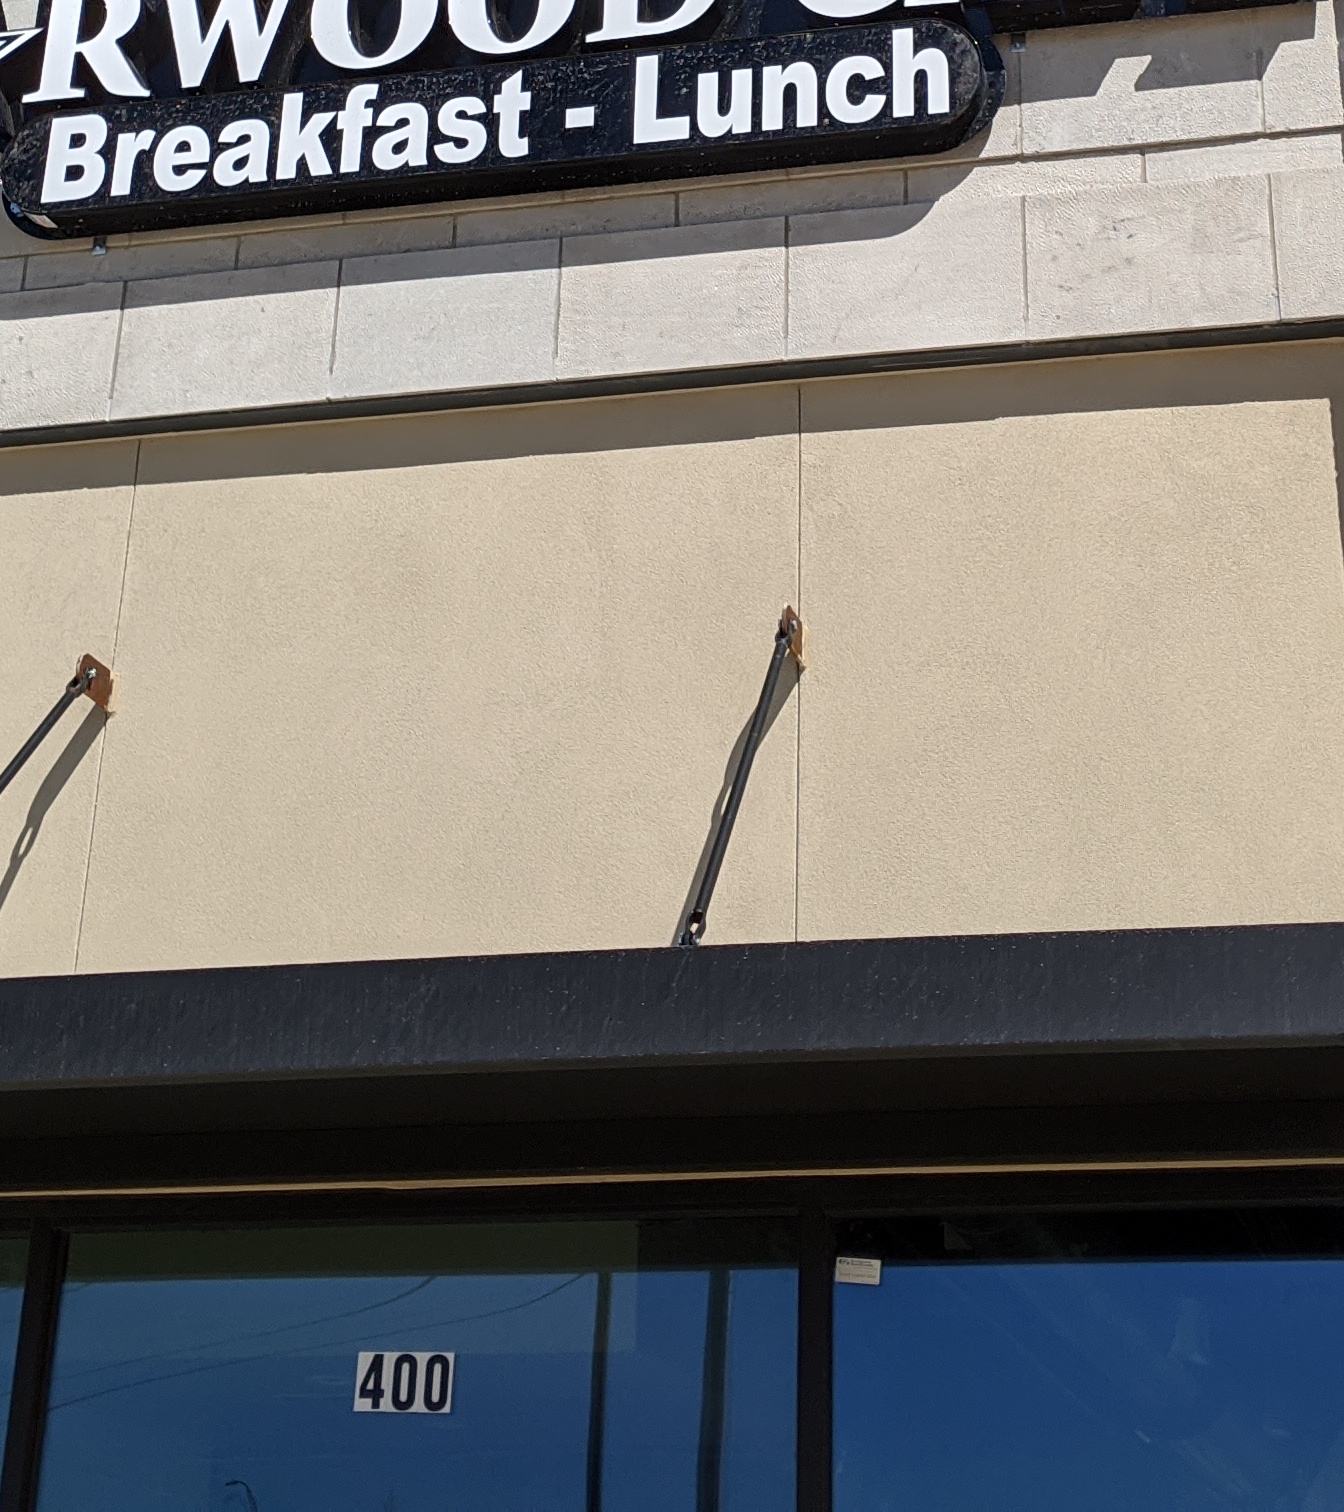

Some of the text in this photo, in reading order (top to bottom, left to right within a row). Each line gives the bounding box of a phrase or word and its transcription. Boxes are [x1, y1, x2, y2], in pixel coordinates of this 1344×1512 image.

[41, 69, 532, 204] Breakfast
[632, 28, 951, 145] Lunch
[358, 1353, 450, 1412] 400
